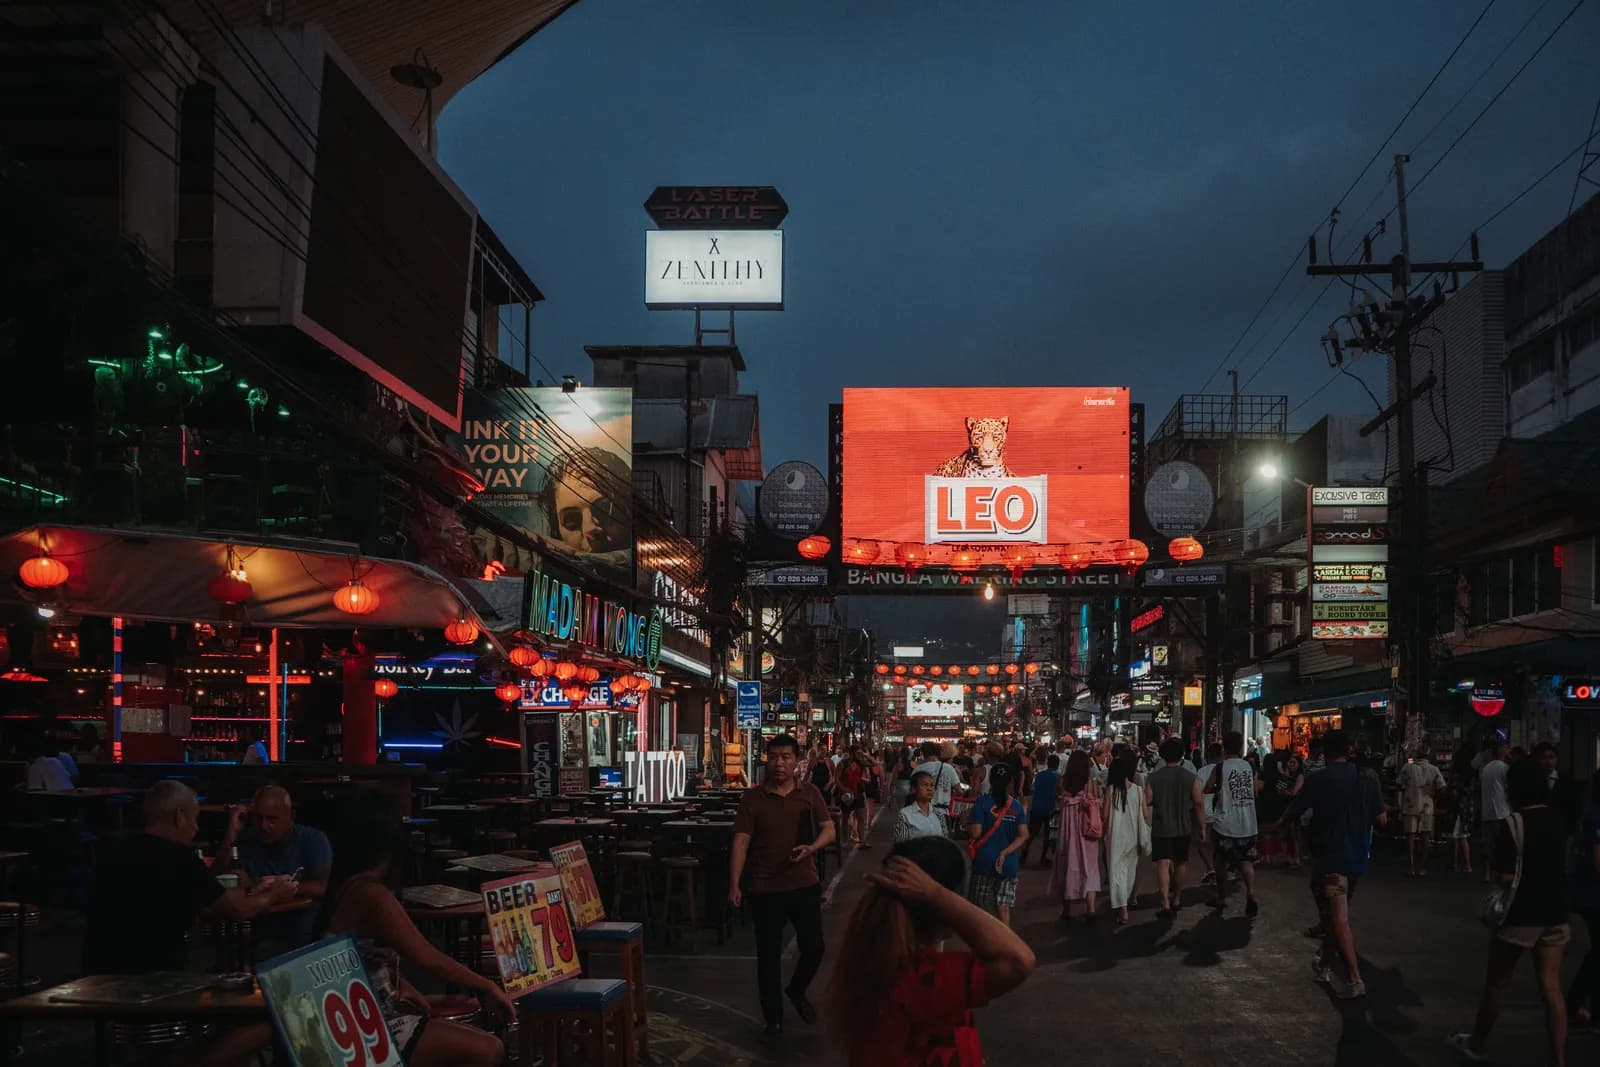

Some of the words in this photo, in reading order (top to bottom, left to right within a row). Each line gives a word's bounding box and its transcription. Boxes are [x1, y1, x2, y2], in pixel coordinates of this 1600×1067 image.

[664, 205, 763, 220] BATTLE
[671, 188, 760, 202] LASER
[465, 420, 511, 439] INK
[464, 443, 541, 464] YOUR
[937, 485, 1038, 535] LEO
[847, 568, 933, 585] BANGLA
[529, 570, 601, 648] MADAM
[603, 600, 647, 659] WONG
[624, 751, 687, 803] TATTOO
[486, 881, 538, 915] BEER
[530, 903, 573, 969] 79
[306, 948, 361, 989] MOJITO
[323, 980, 390, 1067] 99
